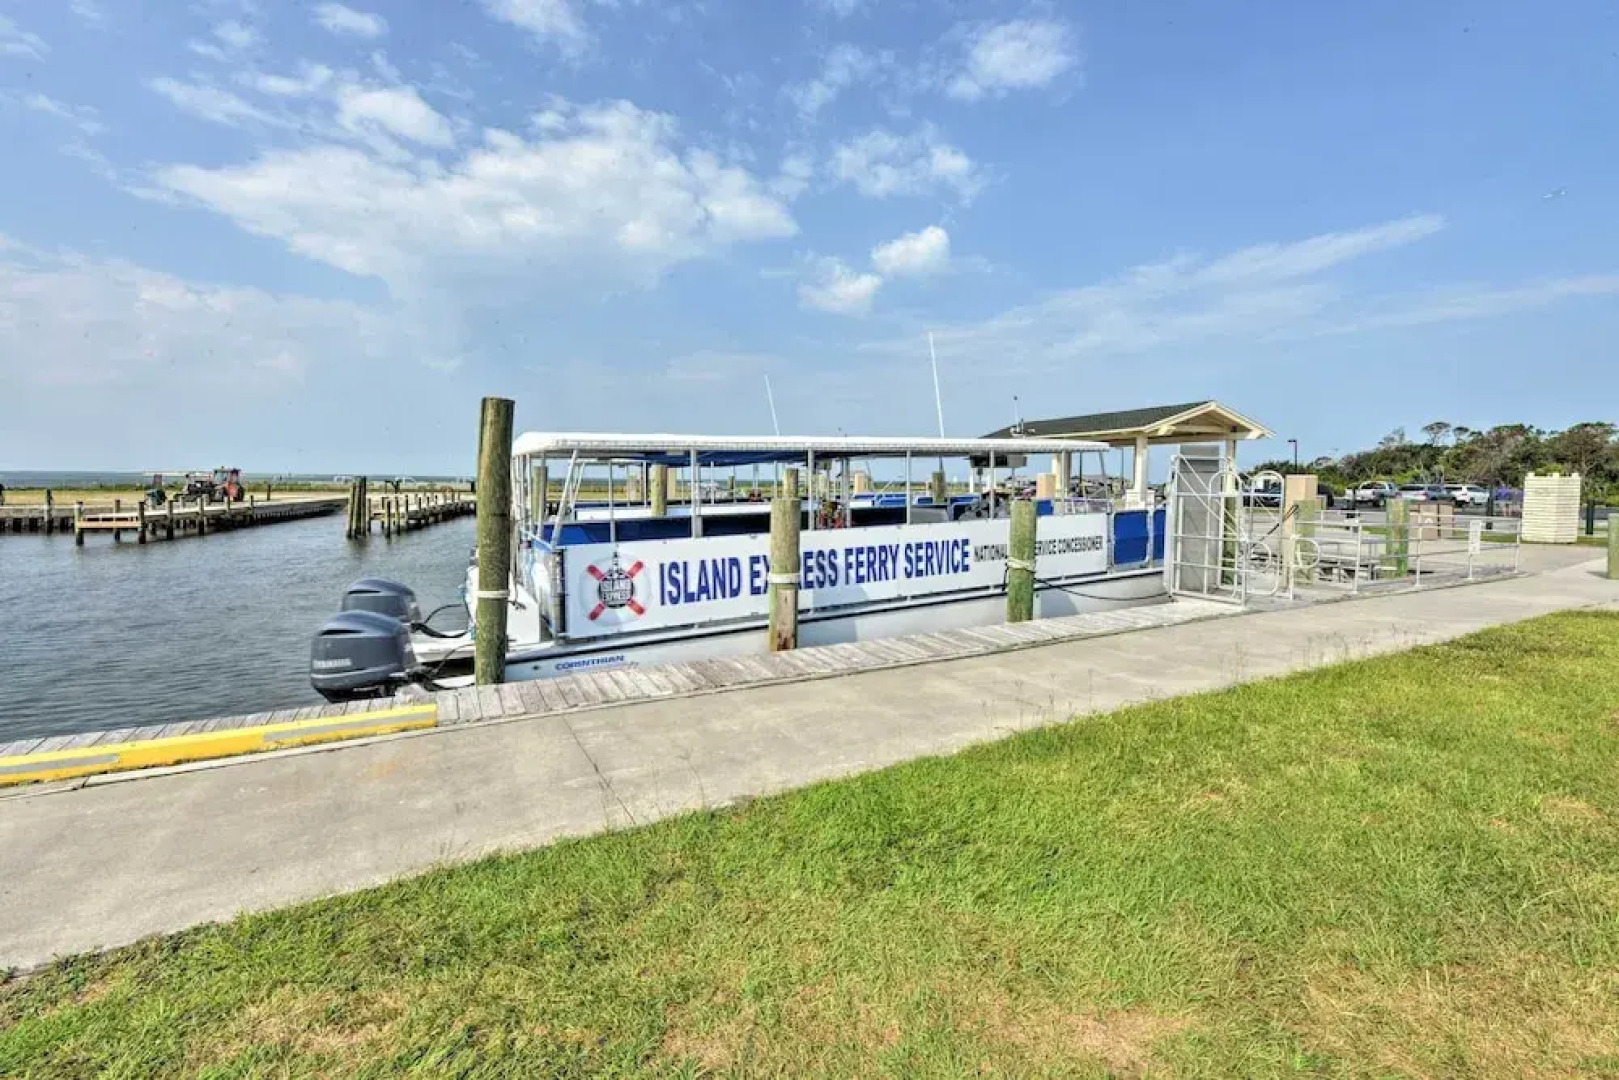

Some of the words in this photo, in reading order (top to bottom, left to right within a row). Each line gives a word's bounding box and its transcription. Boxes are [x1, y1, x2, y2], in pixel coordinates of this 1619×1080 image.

[659, 556, 742, 606] ISLAND
[844, 543, 900, 585] FERRY
[904, 538, 970, 579] SERVICE
